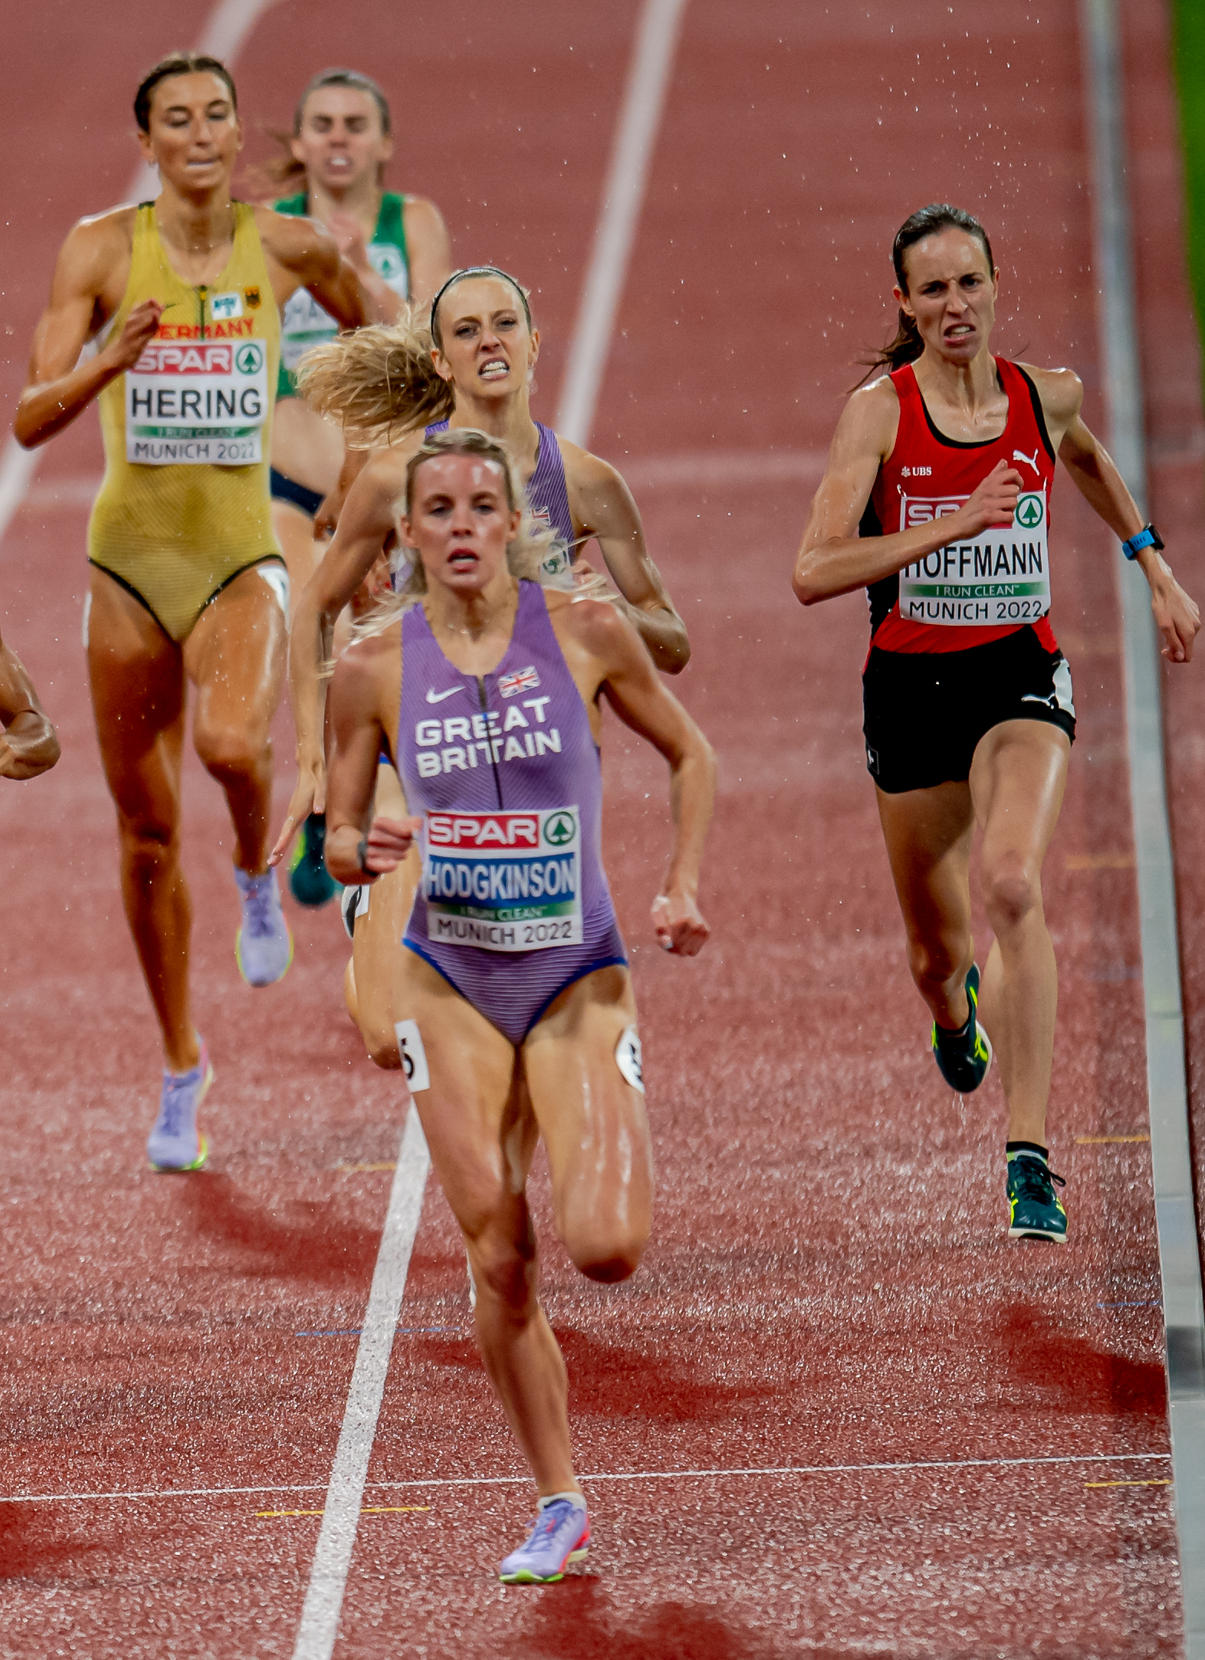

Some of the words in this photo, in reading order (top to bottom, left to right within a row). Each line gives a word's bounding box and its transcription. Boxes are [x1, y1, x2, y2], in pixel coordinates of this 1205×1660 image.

[153, 318, 255, 341] ERMANY
[135, 348, 231, 372] SPAR
[131, 388, 262, 420] HERING
[134, 442, 210, 459] MUNICH
[217, 442, 256, 459] 2022
[912, 466, 933, 476] UBS
[943, 586, 972, 597] RUN
[909, 601, 989, 619] MUNICH
[996, 600, 1042, 619] 2022
[415, 695, 552, 747] GREAT
[415, 728, 563, 779] BRITAIN
[428, 816, 537, 846] SPAR
[428, 857, 577, 900] HODGKINSON
[437, 918, 516, 945] MUNICH
[523, 920, 572, 944] 2022
